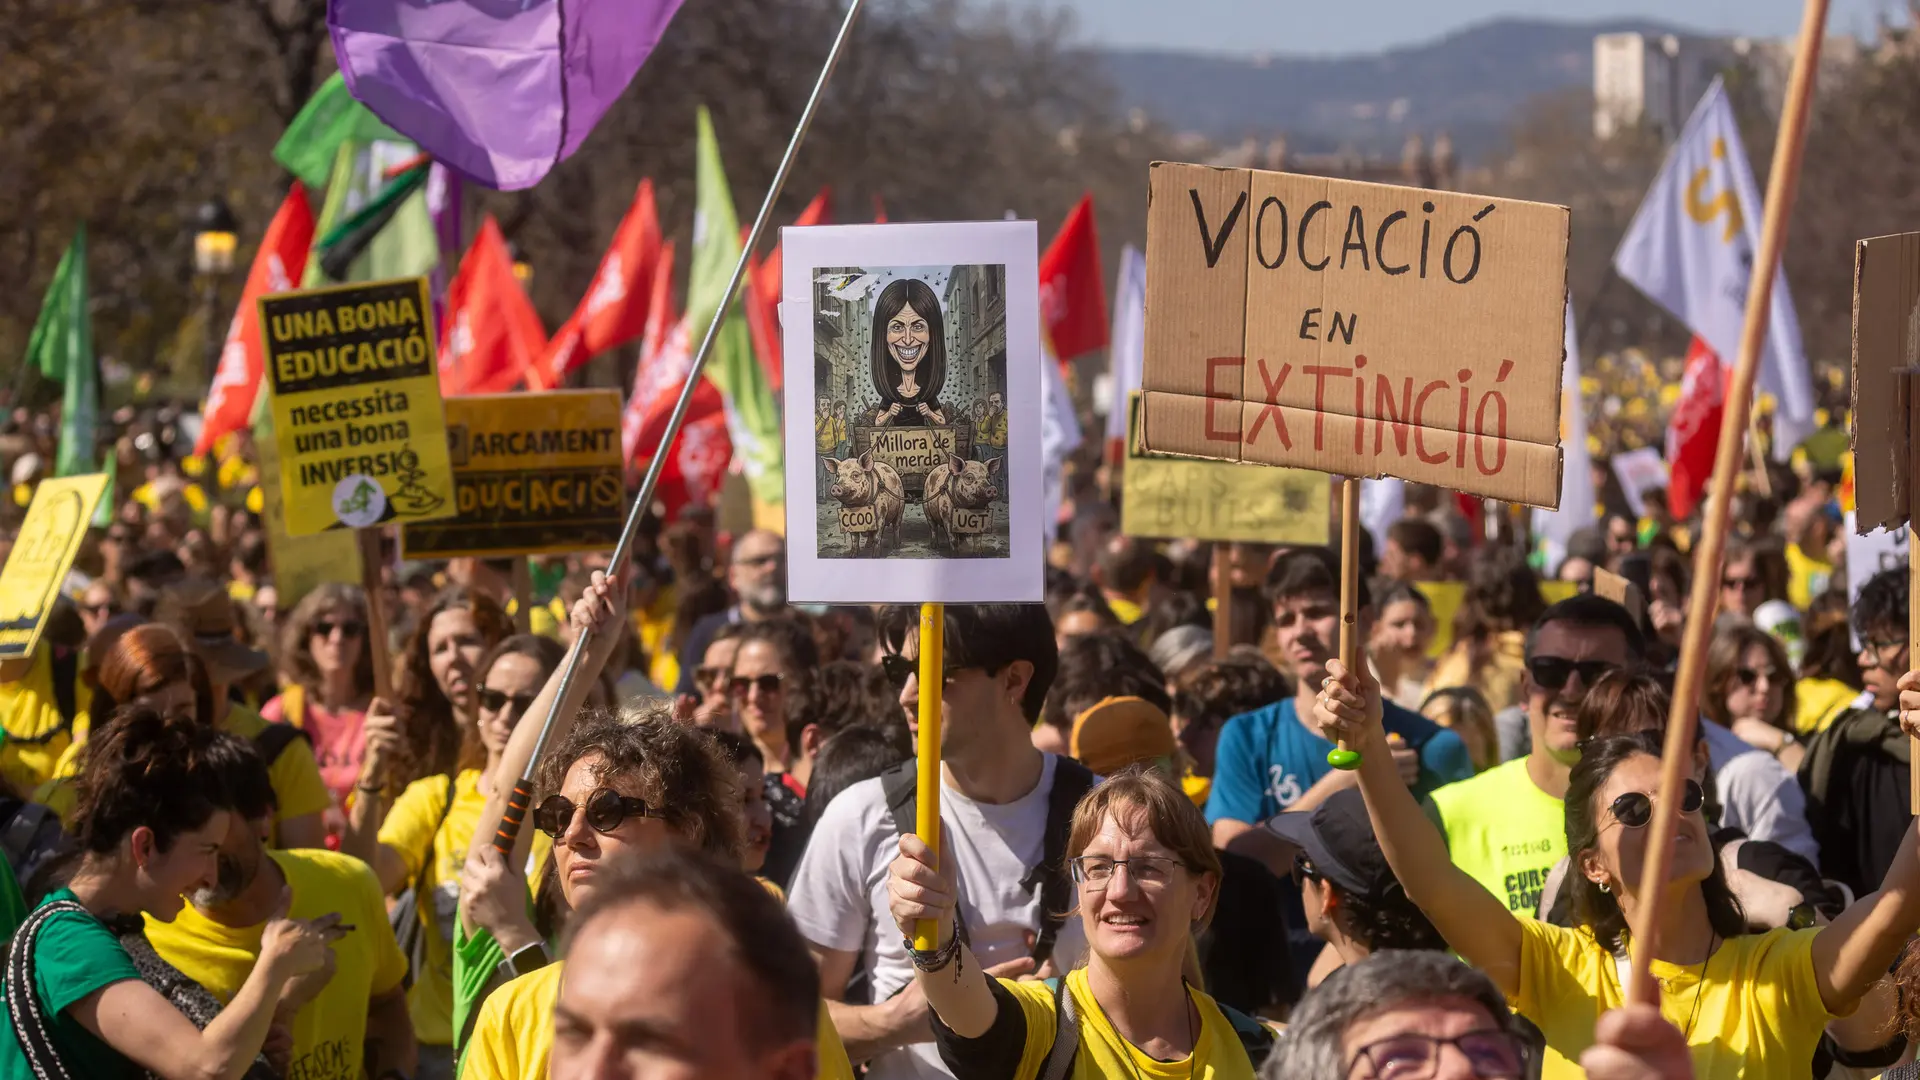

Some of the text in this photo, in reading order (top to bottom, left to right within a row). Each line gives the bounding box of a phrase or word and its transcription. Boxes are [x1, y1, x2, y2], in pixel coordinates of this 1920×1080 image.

[1188, 188, 1496, 284] VOCACIÓ
[271, 309, 334, 342] UNA
[336, 298, 419, 333] BONA
[1299, 308, 1358, 345] EN
[275, 328, 426, 384] EDUCACIÓ
[290, 388, 409, 427] necessita
[1204, 353, 1515, 477] EXTINCIÓ
[294, 419, 409, 454] una bona
[876, 432, 950, 453] Millora de
[895, 449, 941, 468] merda
[841, 511, 873, 528] CCOO
[957, 513, 988, 529] UGT
